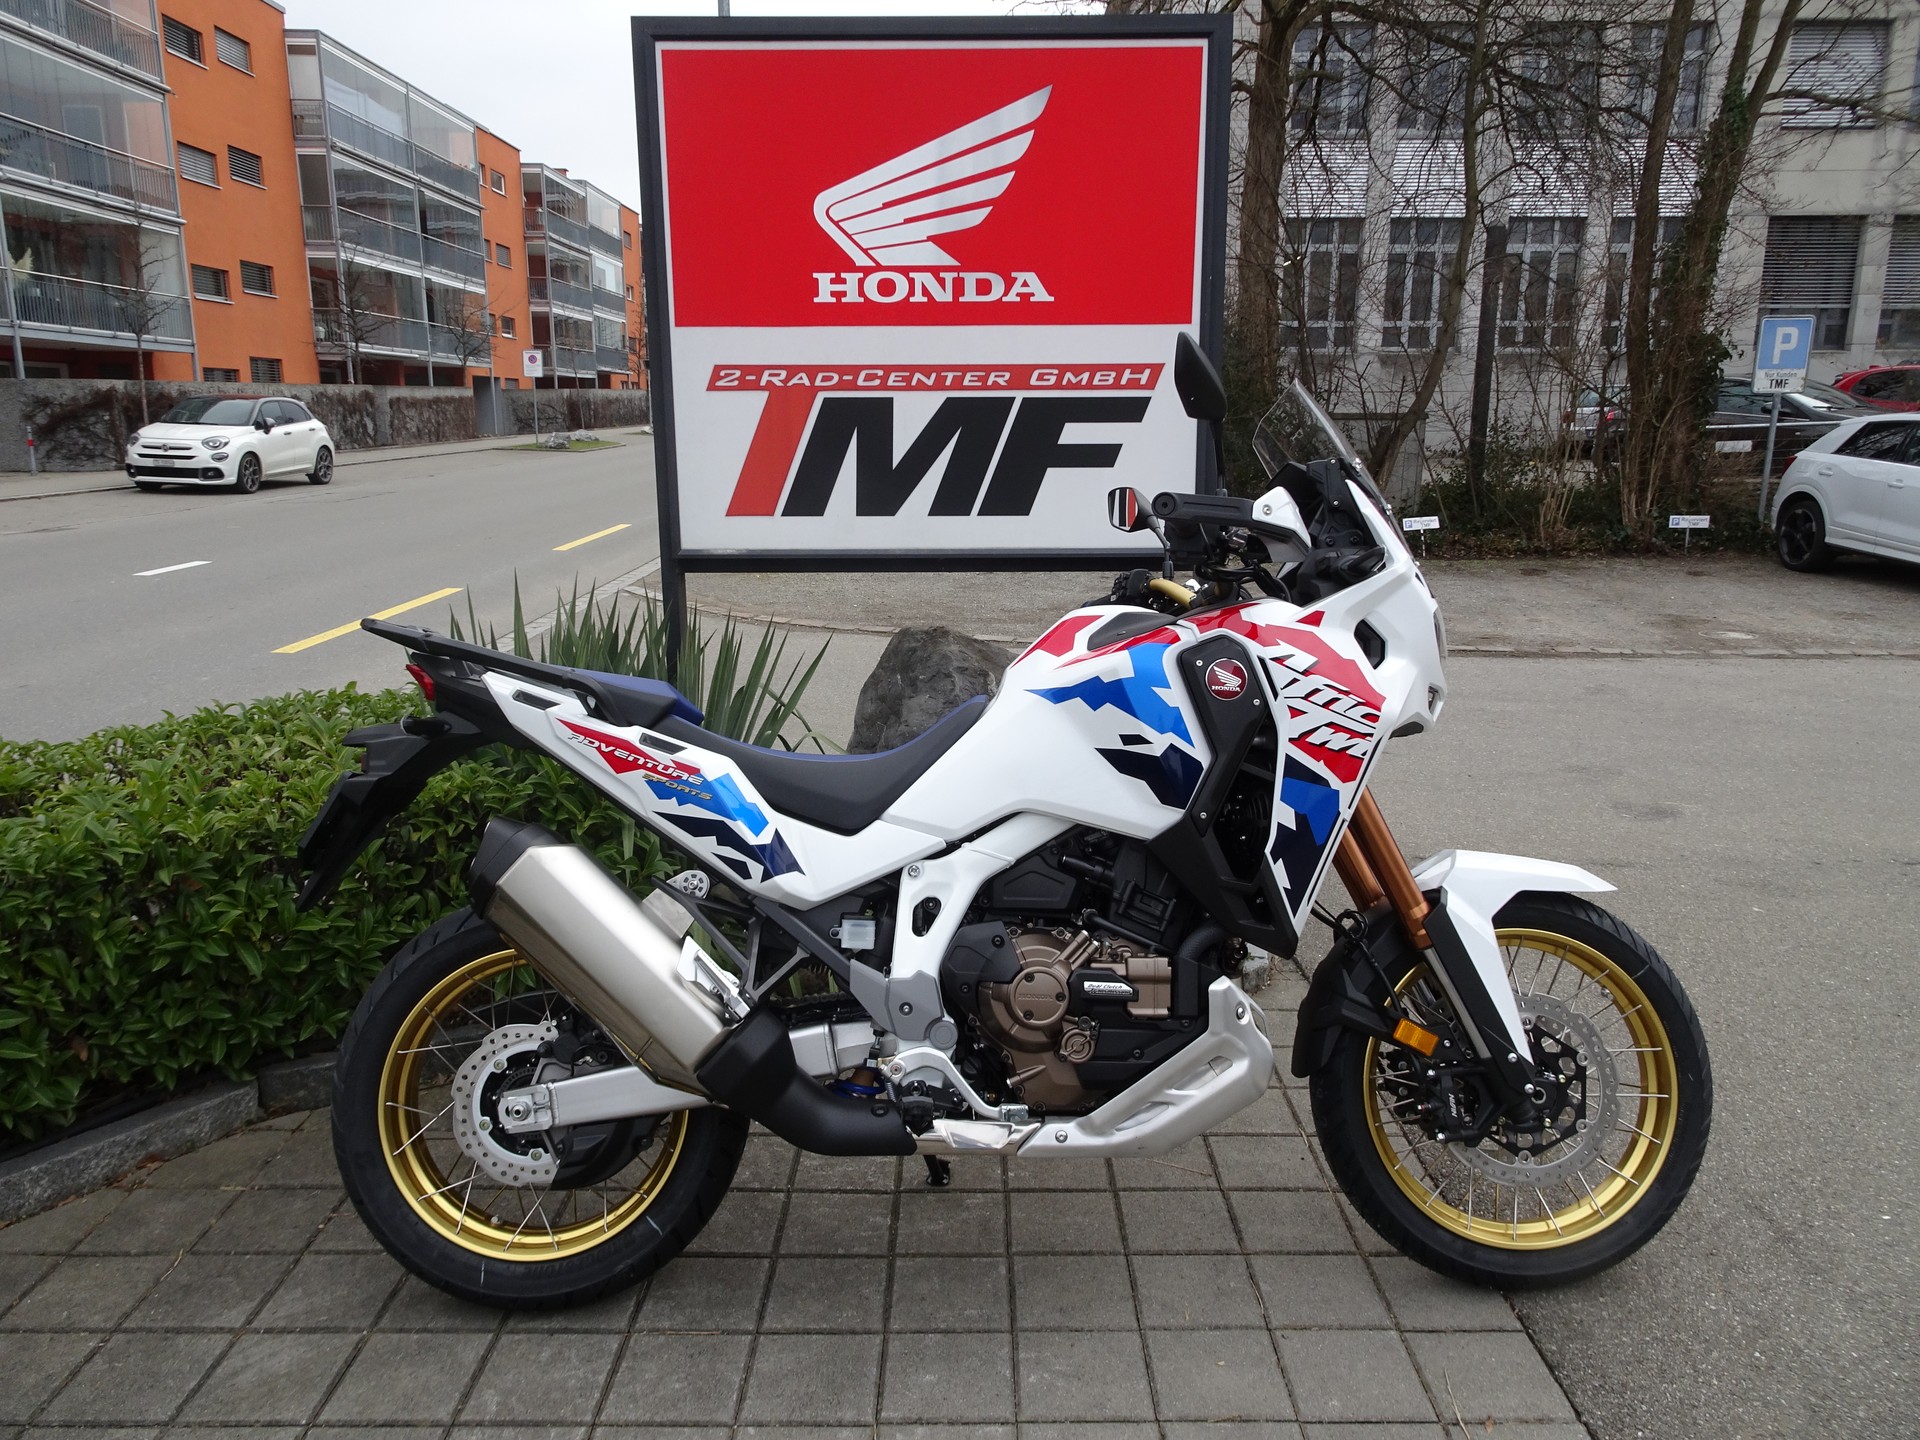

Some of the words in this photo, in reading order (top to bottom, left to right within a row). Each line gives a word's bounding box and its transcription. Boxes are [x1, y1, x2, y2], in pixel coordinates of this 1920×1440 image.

[813, 271, 1054, 303] HONDA
[1772, 327, 1799, 364] P
[1769, 379, 1789, 389] TMF
[724, 393, 1152, 516] TMF
[567, 733, 704, 785] ADVENTURE
[642, 773, 713, 800] SPORTS
